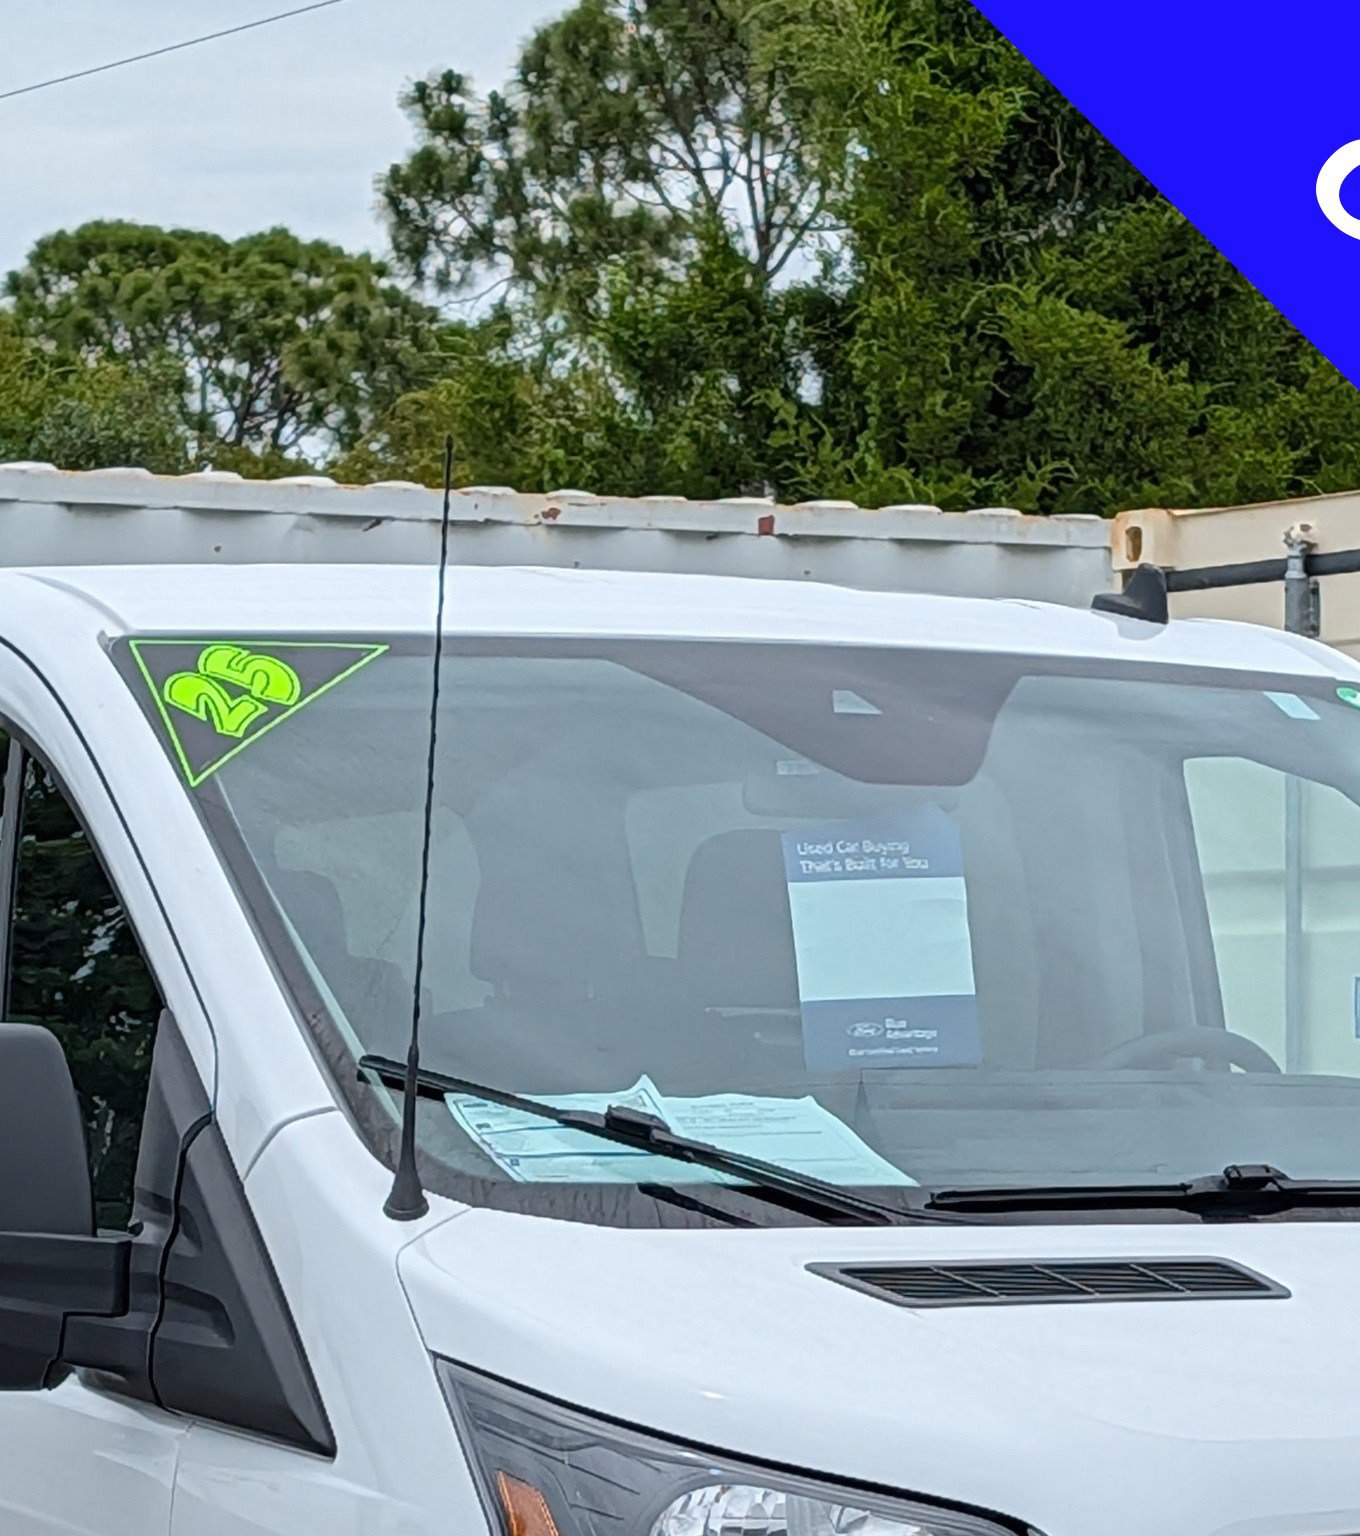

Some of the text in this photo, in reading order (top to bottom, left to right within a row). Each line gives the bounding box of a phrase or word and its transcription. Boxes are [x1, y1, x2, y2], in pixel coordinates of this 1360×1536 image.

[164, 645, 301, 738] 25
[797, 841, 833, 855] Used
[837, 840, 859, 853] Car
